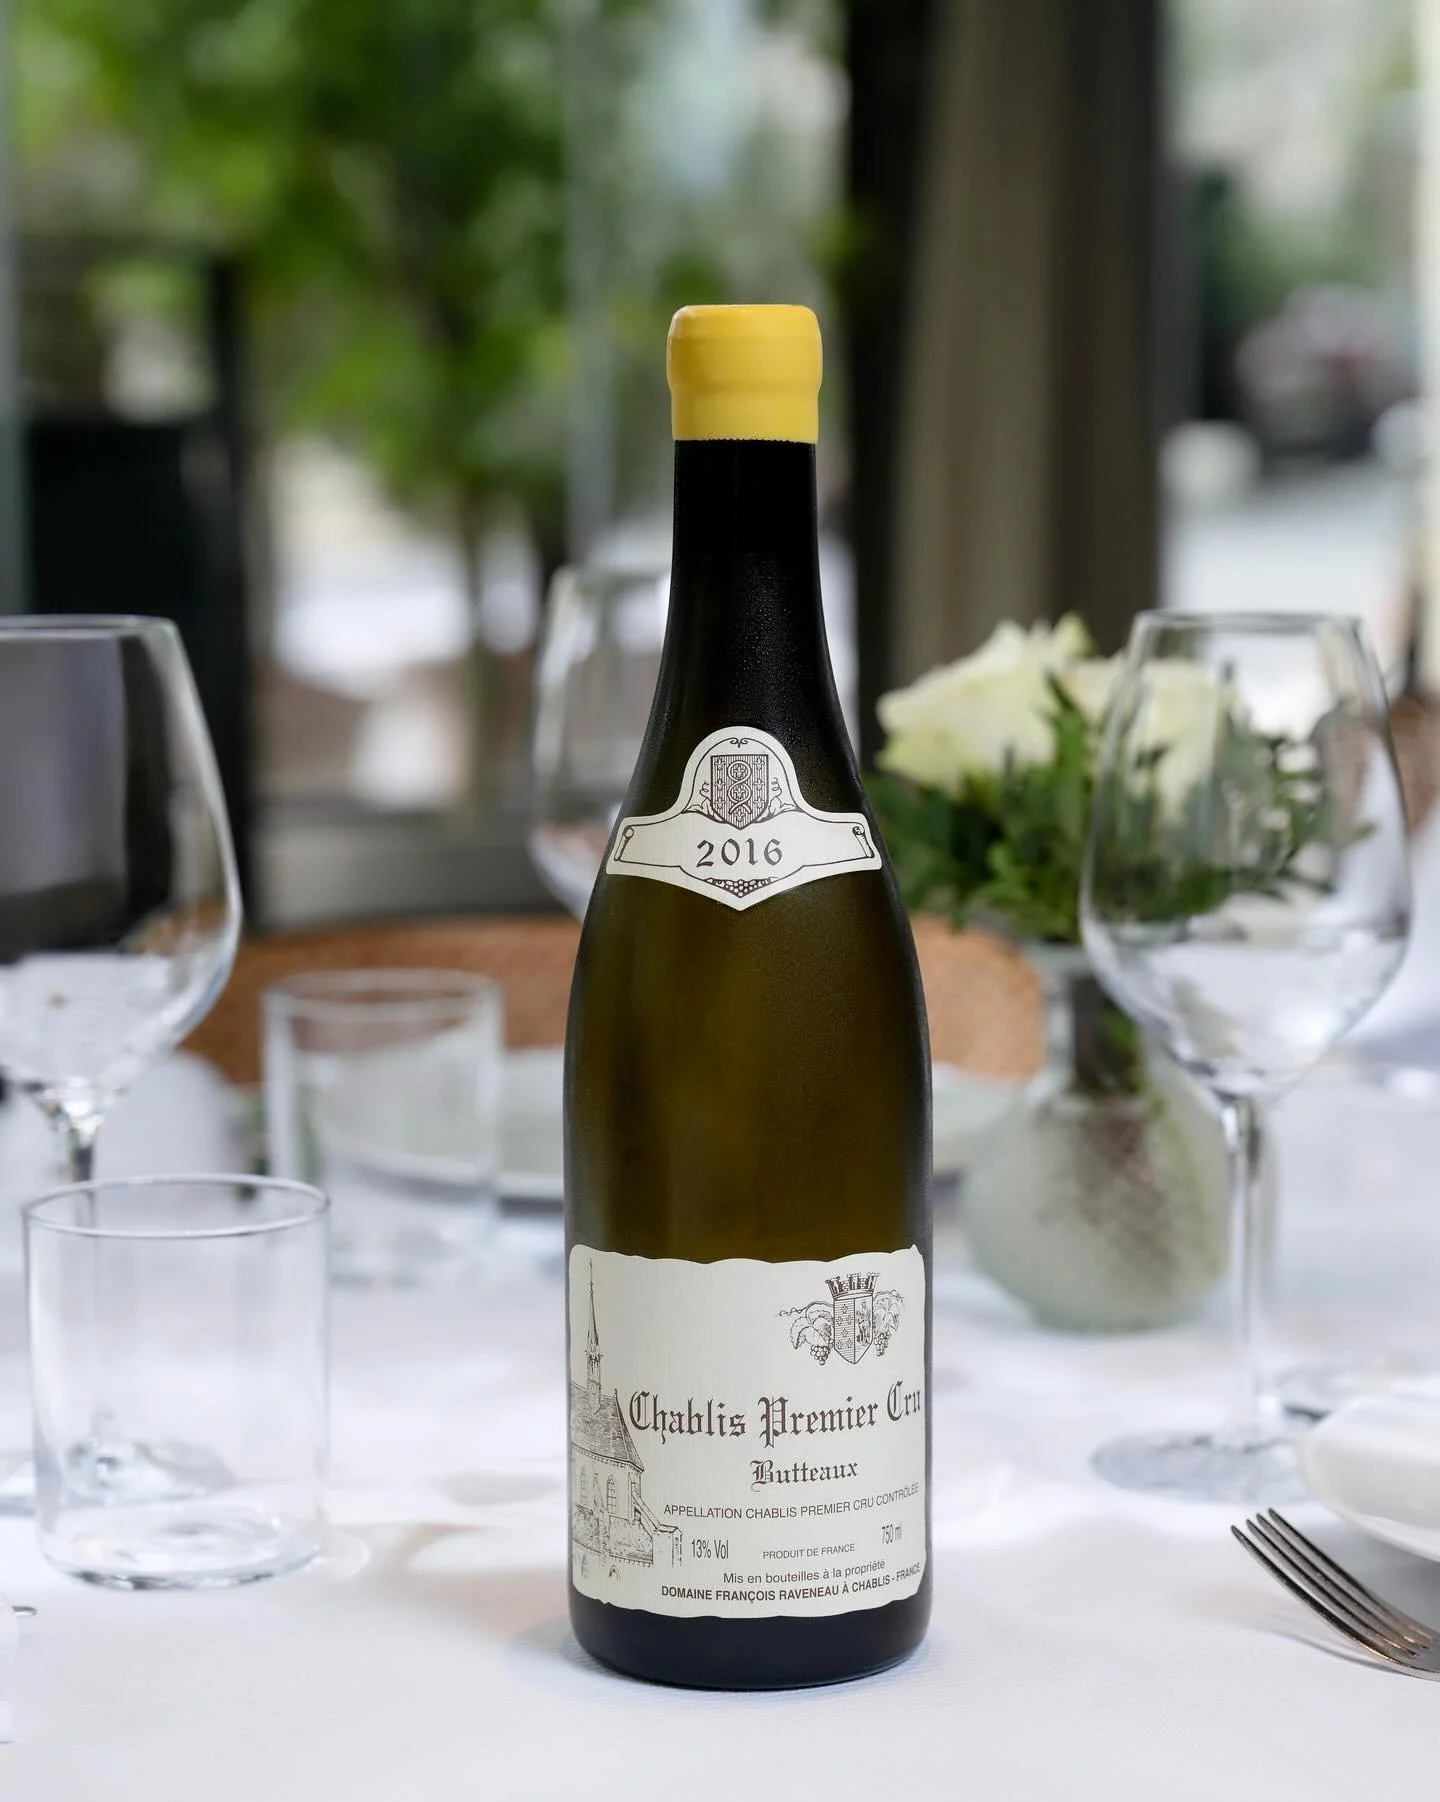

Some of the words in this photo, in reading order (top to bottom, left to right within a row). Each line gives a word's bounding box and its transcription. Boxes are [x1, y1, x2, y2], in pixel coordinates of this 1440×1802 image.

[696, 838, 783, 868] 2016
[629, 1390, 748, 1445] Chablis
[757, 1395, 879, 1449] Premier
[887, 1380, 921, 1421] Cru
[750, 1459, 858, 1493] Butteaux
[663, 1504, 742, 1519] APPELLATION
[745, 1506, 797, 1519] CHABLIS
[800, 1501, 851, 1517] PREMIER
[853, 1497, 874, 1511] CRU
[876, 1482, 919, 1506] CONTRÔLÉE
[881, 1524, 893, 1544] 750
[691, 1539, 712, 1560] 13%
[714, 1539, 729, 1560] Vol
[762, 1549, 804, 1559] PRODUIT
[806, 1548, 819, 1557] DE
[821, 1543, 856, 1556] FRANCE
[661, 1585, 712, 1600] DOMAINE
[715, 1590, 776, 1604] FRANÇOIS
[779, 1585, 839, 1601] RAVENEAU
[841, 1581, 850, 1594] À
[851, 1574, 891, 1593] CHABLIS
[896, 1562, 921, 1582] FRANCE
[723, 1572, 744, 1584] Mis
[747, 1575, 762, 1583] en
[765, 1571, 820, 1584] bouteilles
[822, 1568, 830, 1580] à
[832, 1568, 842, 1578] la
[844, 1559, 886, 1578] propriété
